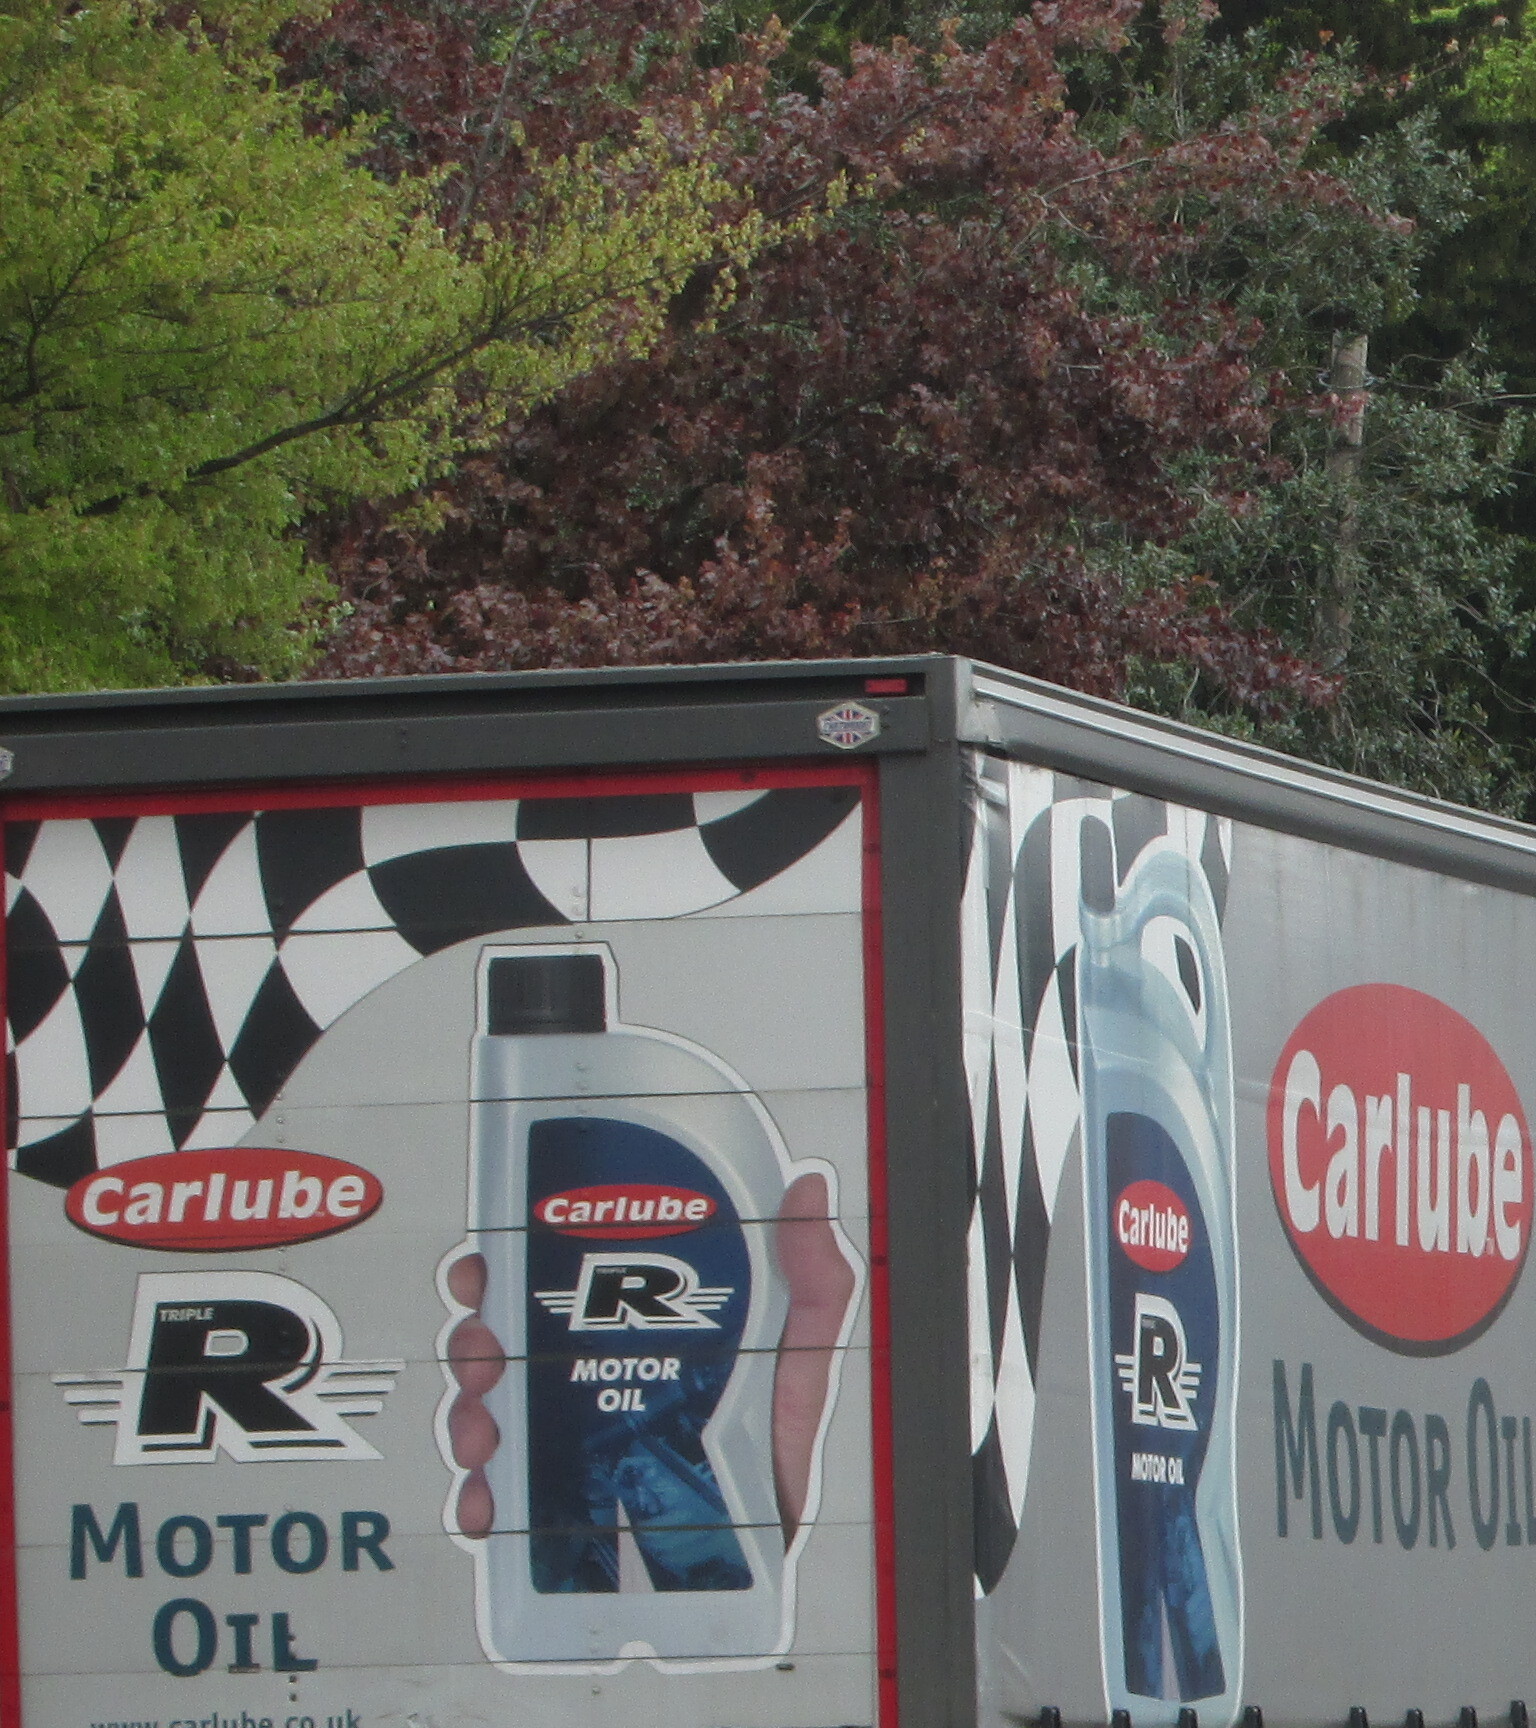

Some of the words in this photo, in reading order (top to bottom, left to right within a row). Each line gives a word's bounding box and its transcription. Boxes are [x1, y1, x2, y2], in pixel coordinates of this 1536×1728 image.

[1282, 1049, 1523, 1261] Carlube
[82, 1170, 367, 1227] Carlube
[543, 1196, 708, 1224] Carlube
[1118, 1198, 1190, 1254] Carlube
[159, 1307, 215, 1322] TRIPLE
[570, 1357, 682, 1382] MOTOR
[596, 1388, 646, 1412] OIL
[1131, 1451, 1167, 1484] MOTOR
[1272, 1358, 1457, 1551] MOTOR
[70, 1502, 397, 1580] MOTOR
[152, 1598, 319, 1678] OIL
